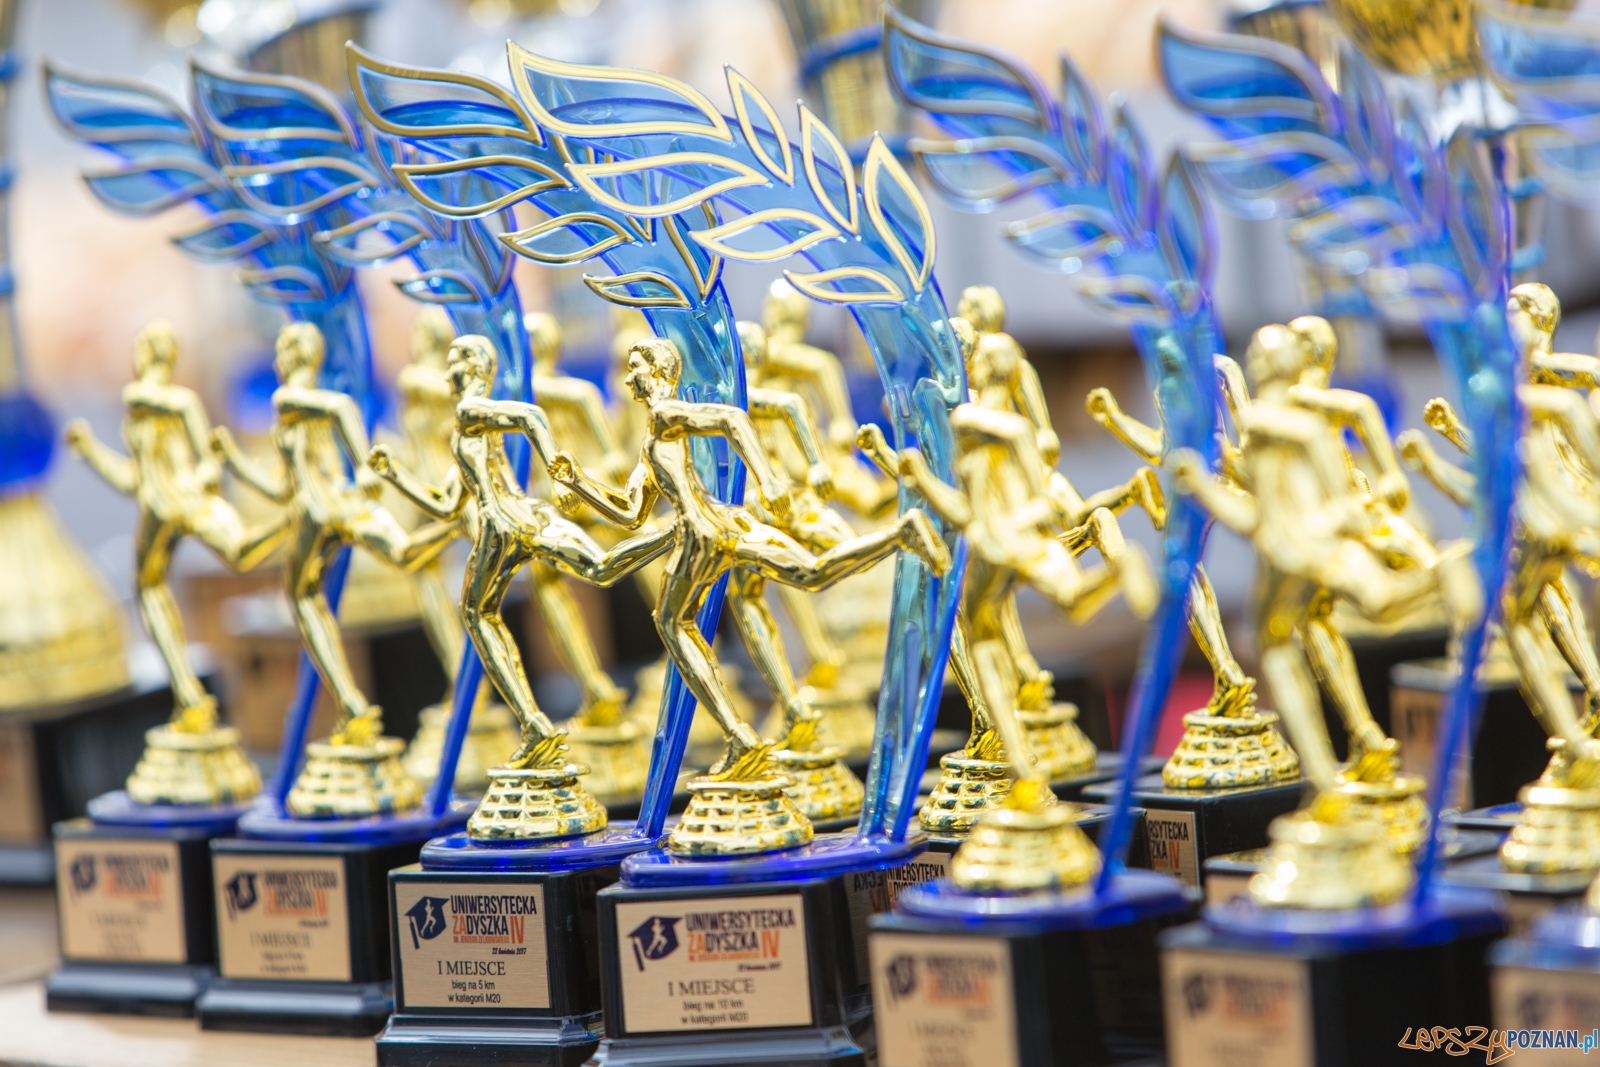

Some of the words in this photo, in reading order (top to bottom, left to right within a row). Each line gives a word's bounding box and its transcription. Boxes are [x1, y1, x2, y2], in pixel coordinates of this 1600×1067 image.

[887, 862, 945, 882] NIWERSYTECKA
[450, 895, 537, 915] UNIWERSYTECKA
[452, 915, 509, 935] ZADYSZKA
[509, 915, 525, 944] IV
[685, 908, 796, 932] UNIWERSYTECKA
[687, 931, 760, 954] ZADYSZKA
[761, 930, 780, 960] IV
[437, 960, 443, 975] I
[446, 961, 506, 976] MIEJSCE
[451, 979, 467, 991] bieg
[468, 982, 477, 990] na
[478, 979, 484, 990] 5
[485, 980, 496, 990] km
[667, 981, 675, 997] I
[678, 977, 756, 996] MIEJSCE
[455, 993, 484, 1005] kategorii
[486, 993, 501, 1003] M20
